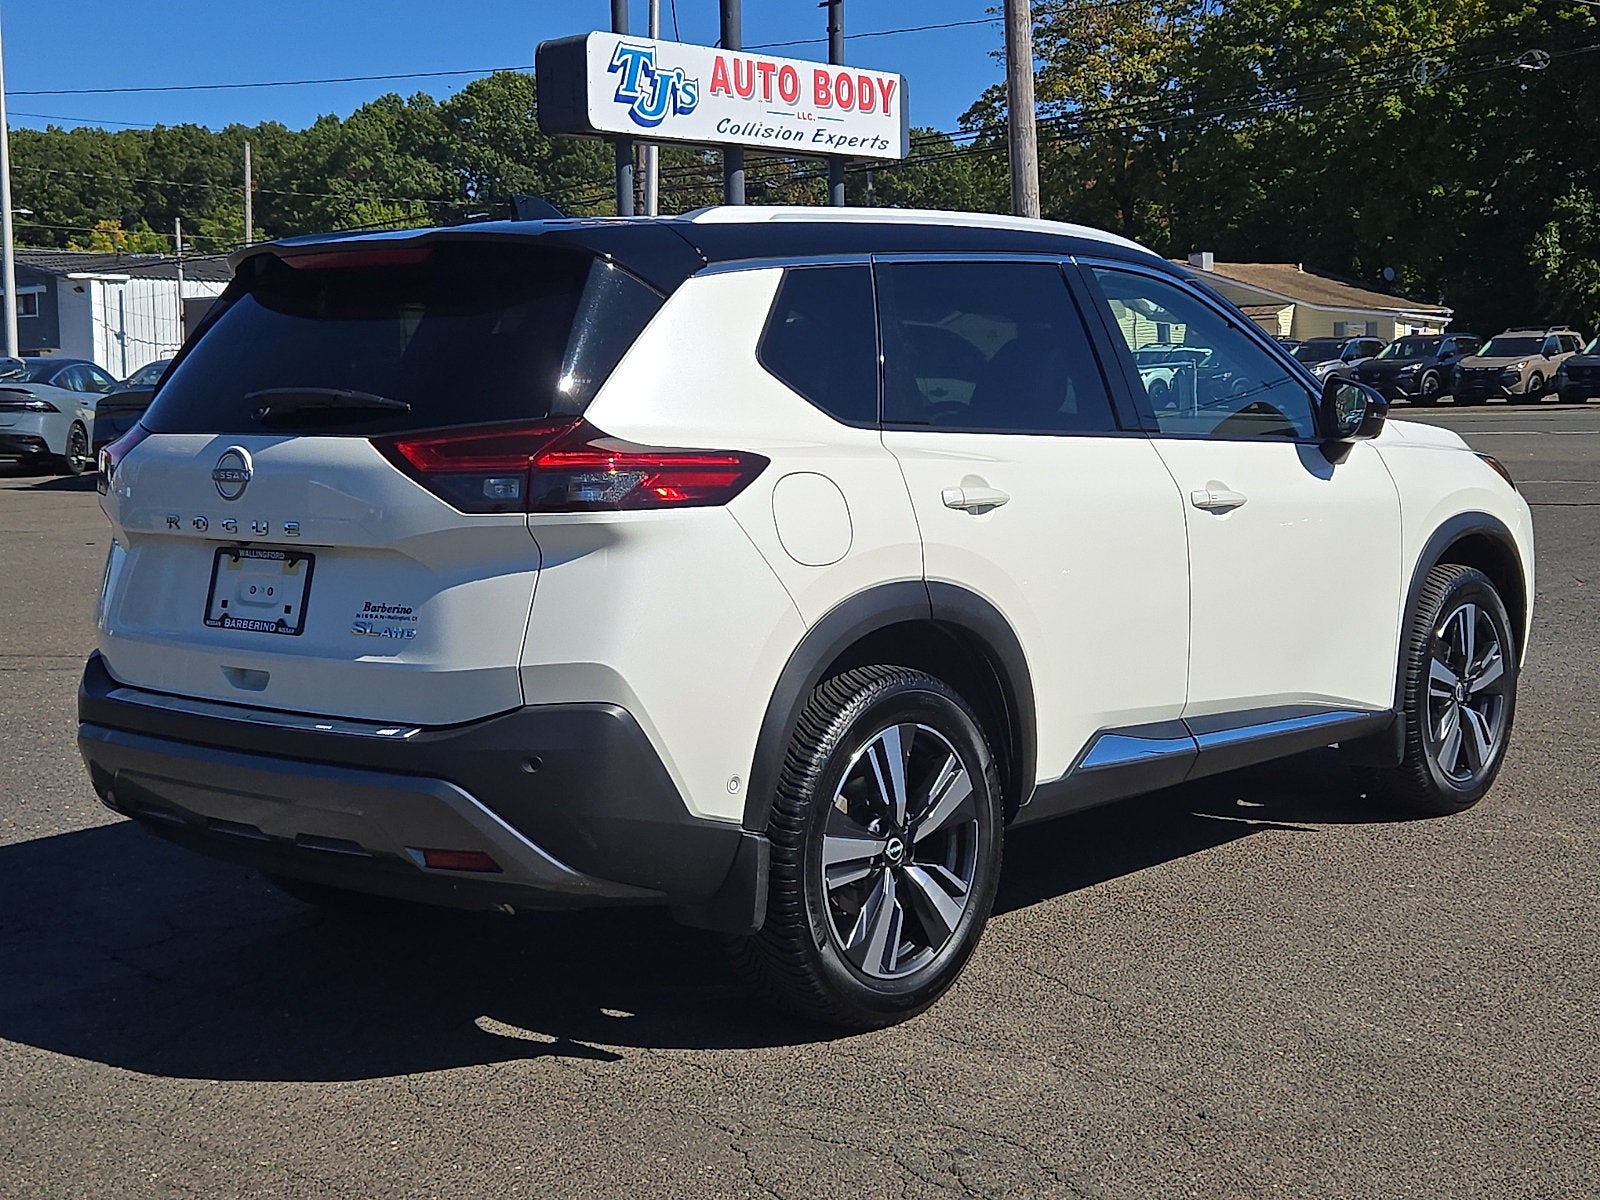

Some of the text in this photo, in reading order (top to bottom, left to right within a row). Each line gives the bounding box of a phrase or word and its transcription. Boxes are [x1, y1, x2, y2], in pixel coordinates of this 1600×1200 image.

[607, 41, 699, 127] TJ's
[710, 55, 897, 115] AUTO BODY
[716, 118, 890, 150] Collision Experts
[213, 470, 250, 481] SSAN
[166, 513, 301, 537] ROGUE
[239, 549, 286, 560] WALLINGFORD
[362, 601, 413, 615] Barberino
[223, 618, 277, 632] BARBERINO
[351, 621, 381, 637] SL
